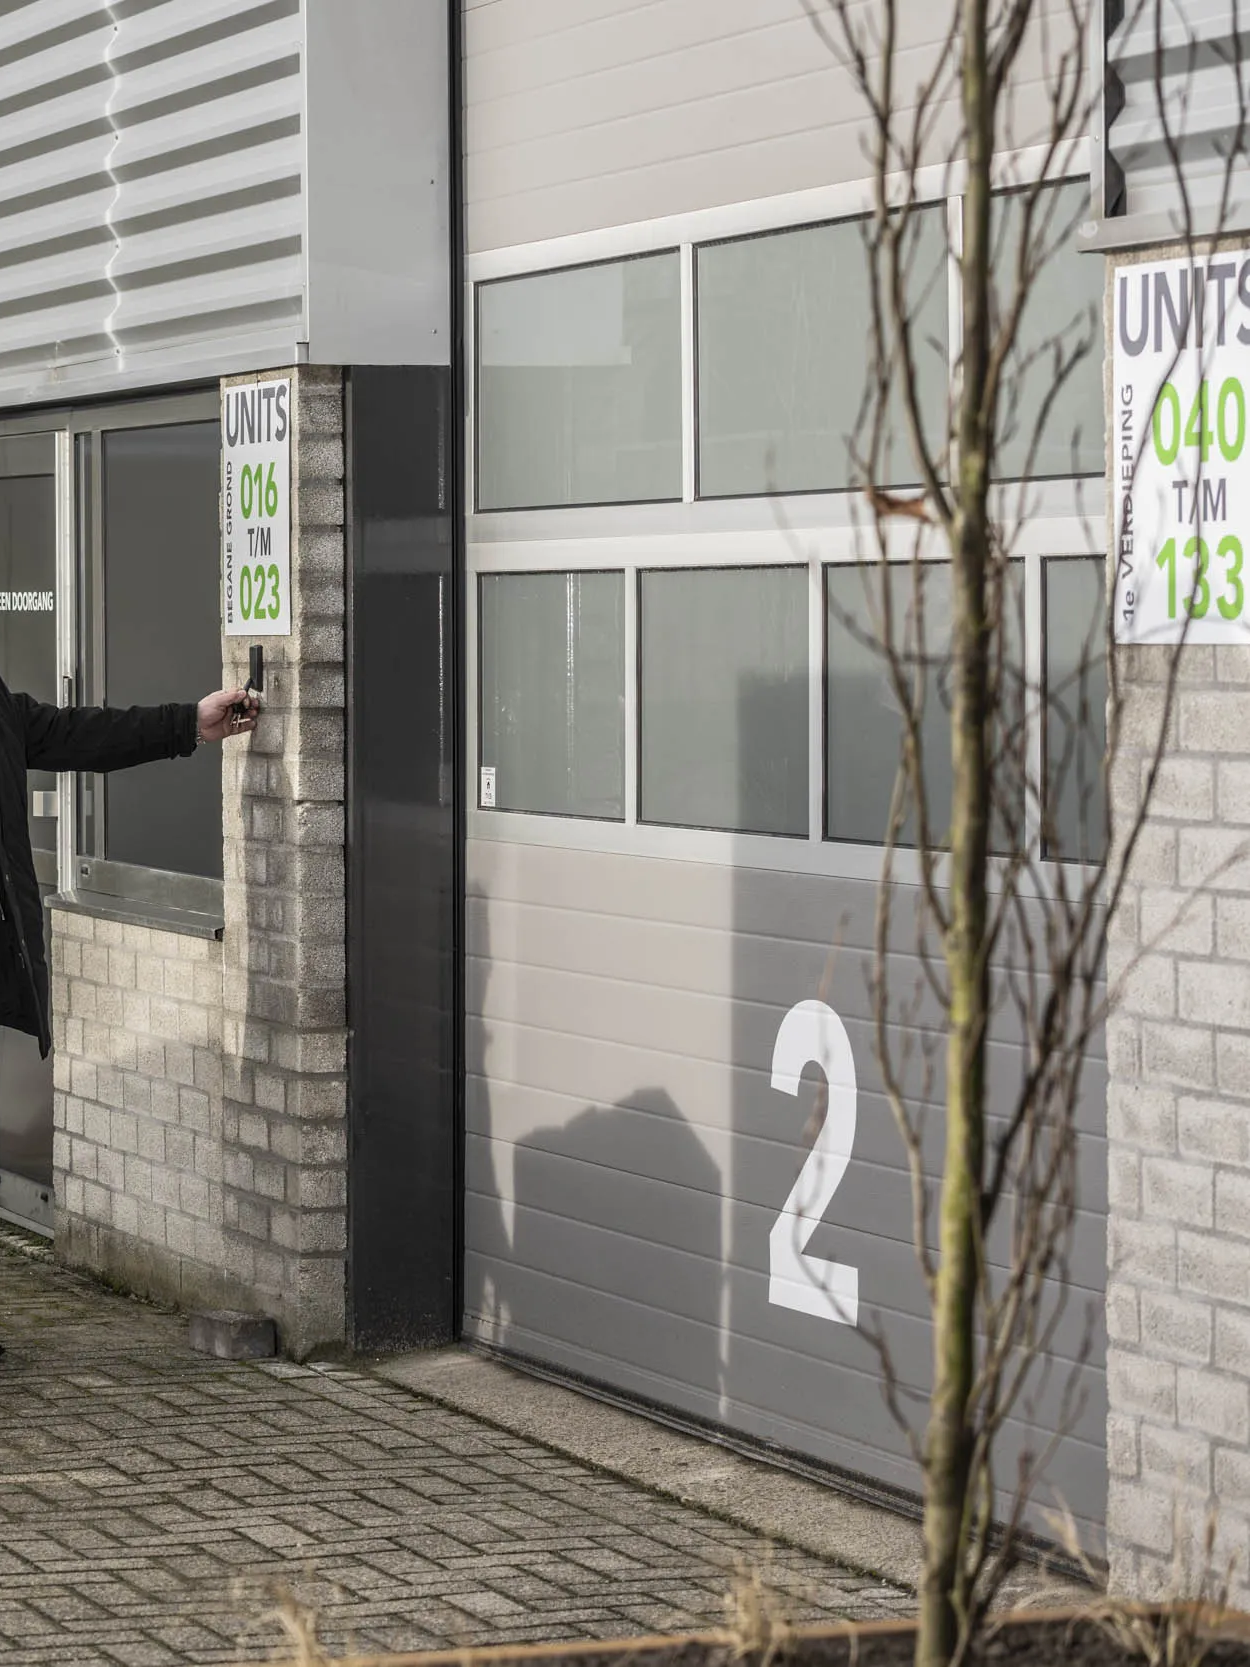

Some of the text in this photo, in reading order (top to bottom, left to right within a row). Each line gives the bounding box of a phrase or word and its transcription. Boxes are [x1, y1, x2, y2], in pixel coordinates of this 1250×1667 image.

[226, 384, 287, 448] UNITS
[1152, 376, 1246, 467] 040
[225, 460, 233, 536] GROND
[240, 461, 279, 520] 016
[1120, 384, 1134, 579] VERDIEPING
[1172, 478, 1227, 526] T/M
[247, 526, 272, 558] T/M
[12, 591, 54, 611] DOORGANG
[239, 563, 281, 621] 023
[1155, 533, 1245, 622] 133
[768, 999, 859, 1328] 2
